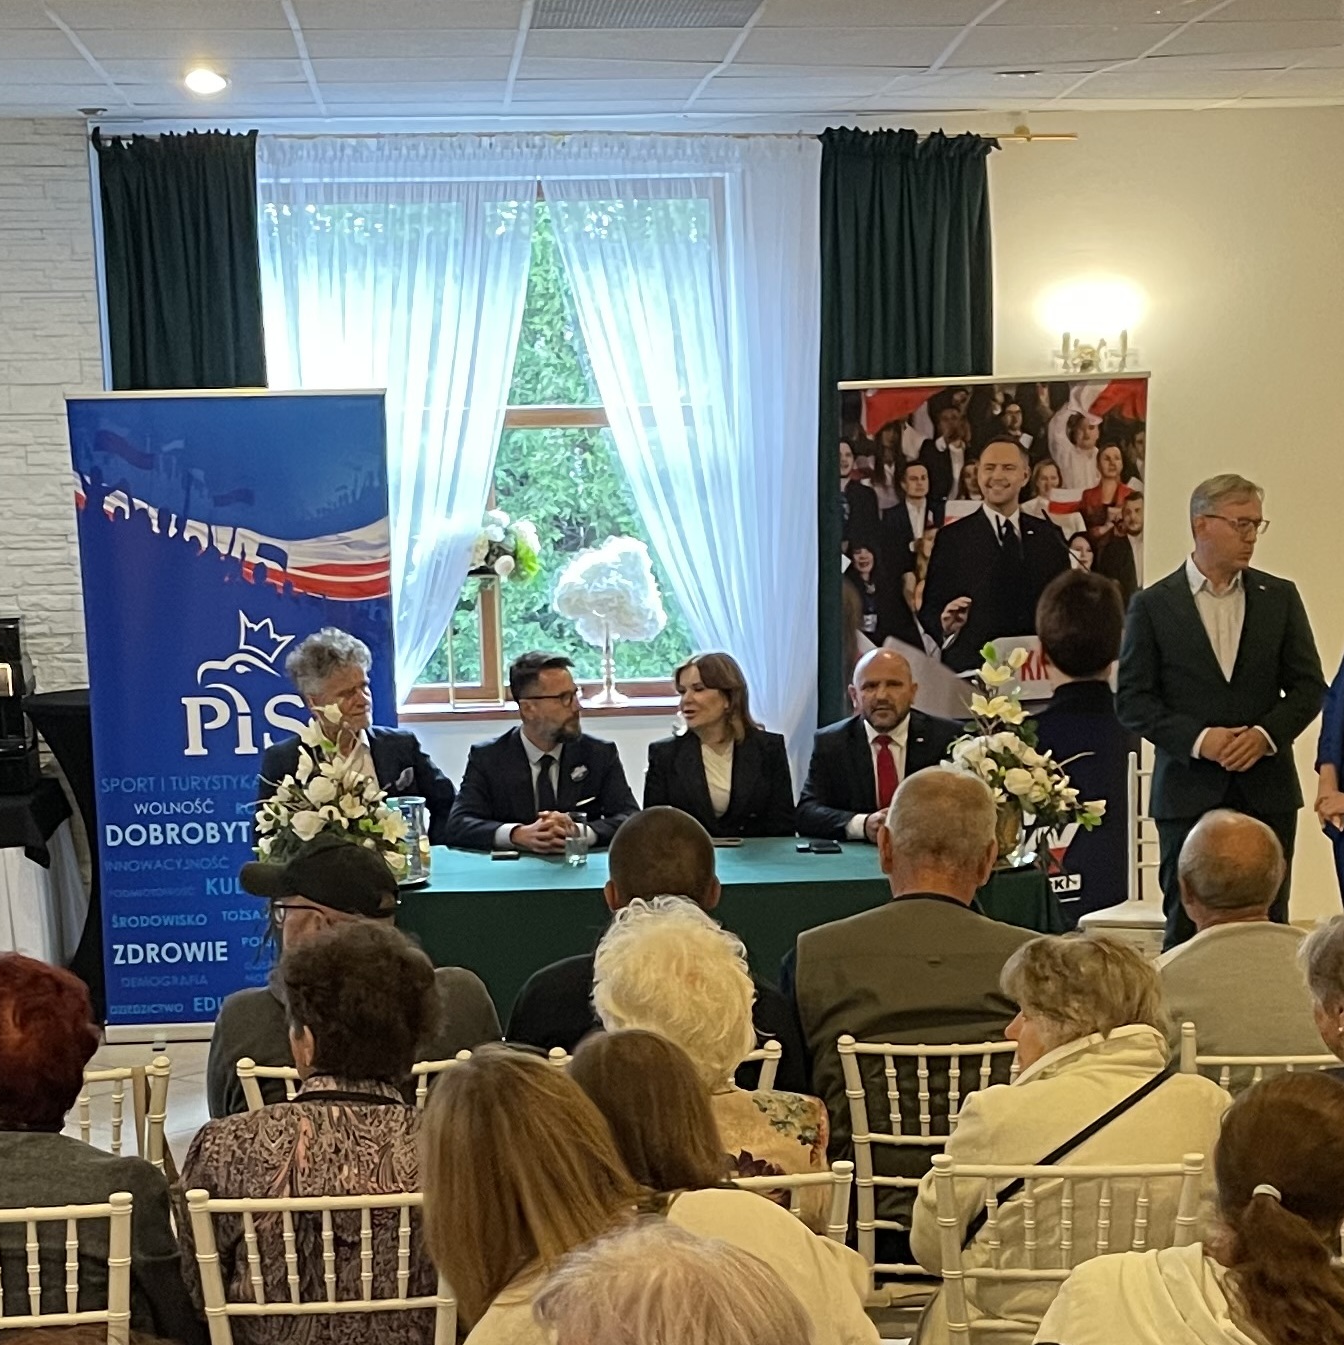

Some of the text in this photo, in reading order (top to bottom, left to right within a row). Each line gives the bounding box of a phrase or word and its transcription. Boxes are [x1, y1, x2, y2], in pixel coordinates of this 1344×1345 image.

[181, 693, 308, 756] PiS
[101, 776, 155, 793] SPORT
[134, 798, 214, 815] WOLNOŚĆ
[106, 821, 250, 847] DOBROBYT
[112, 913, 207, 928] ŚRODOWISKO
[112, 941, 228, 965] ZDROWIE
